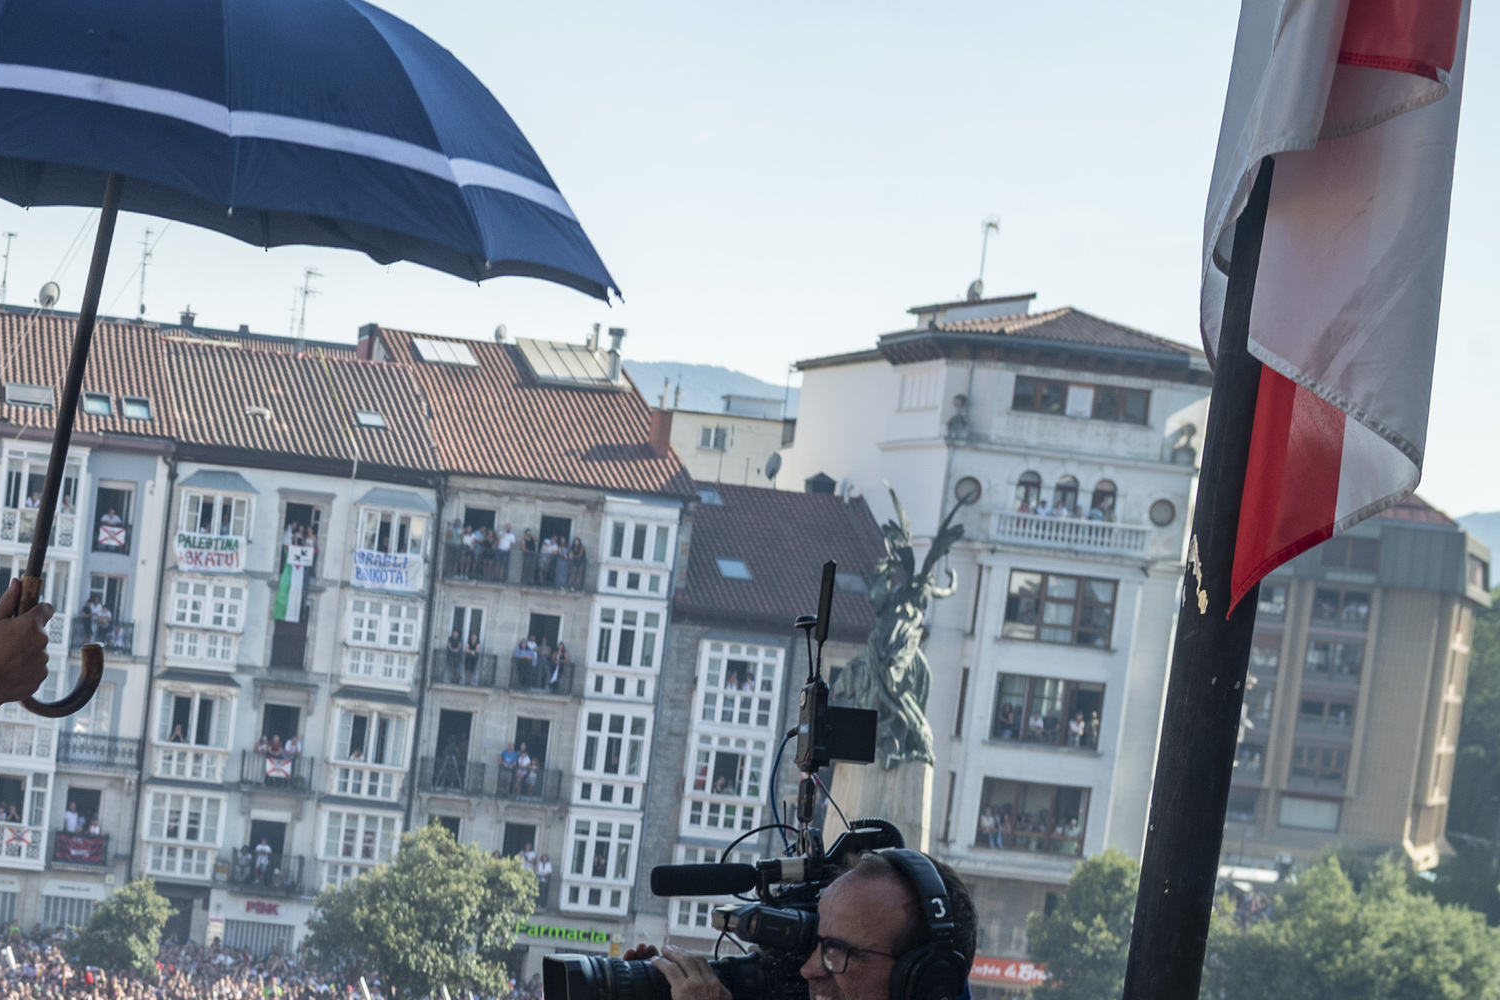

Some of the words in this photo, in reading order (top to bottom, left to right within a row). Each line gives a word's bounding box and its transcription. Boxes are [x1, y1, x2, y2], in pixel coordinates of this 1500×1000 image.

[245, 900, 280, 916] PINK
[931, 897, 946, 919] 3
[515, 920, 607, 944] Farmacia
